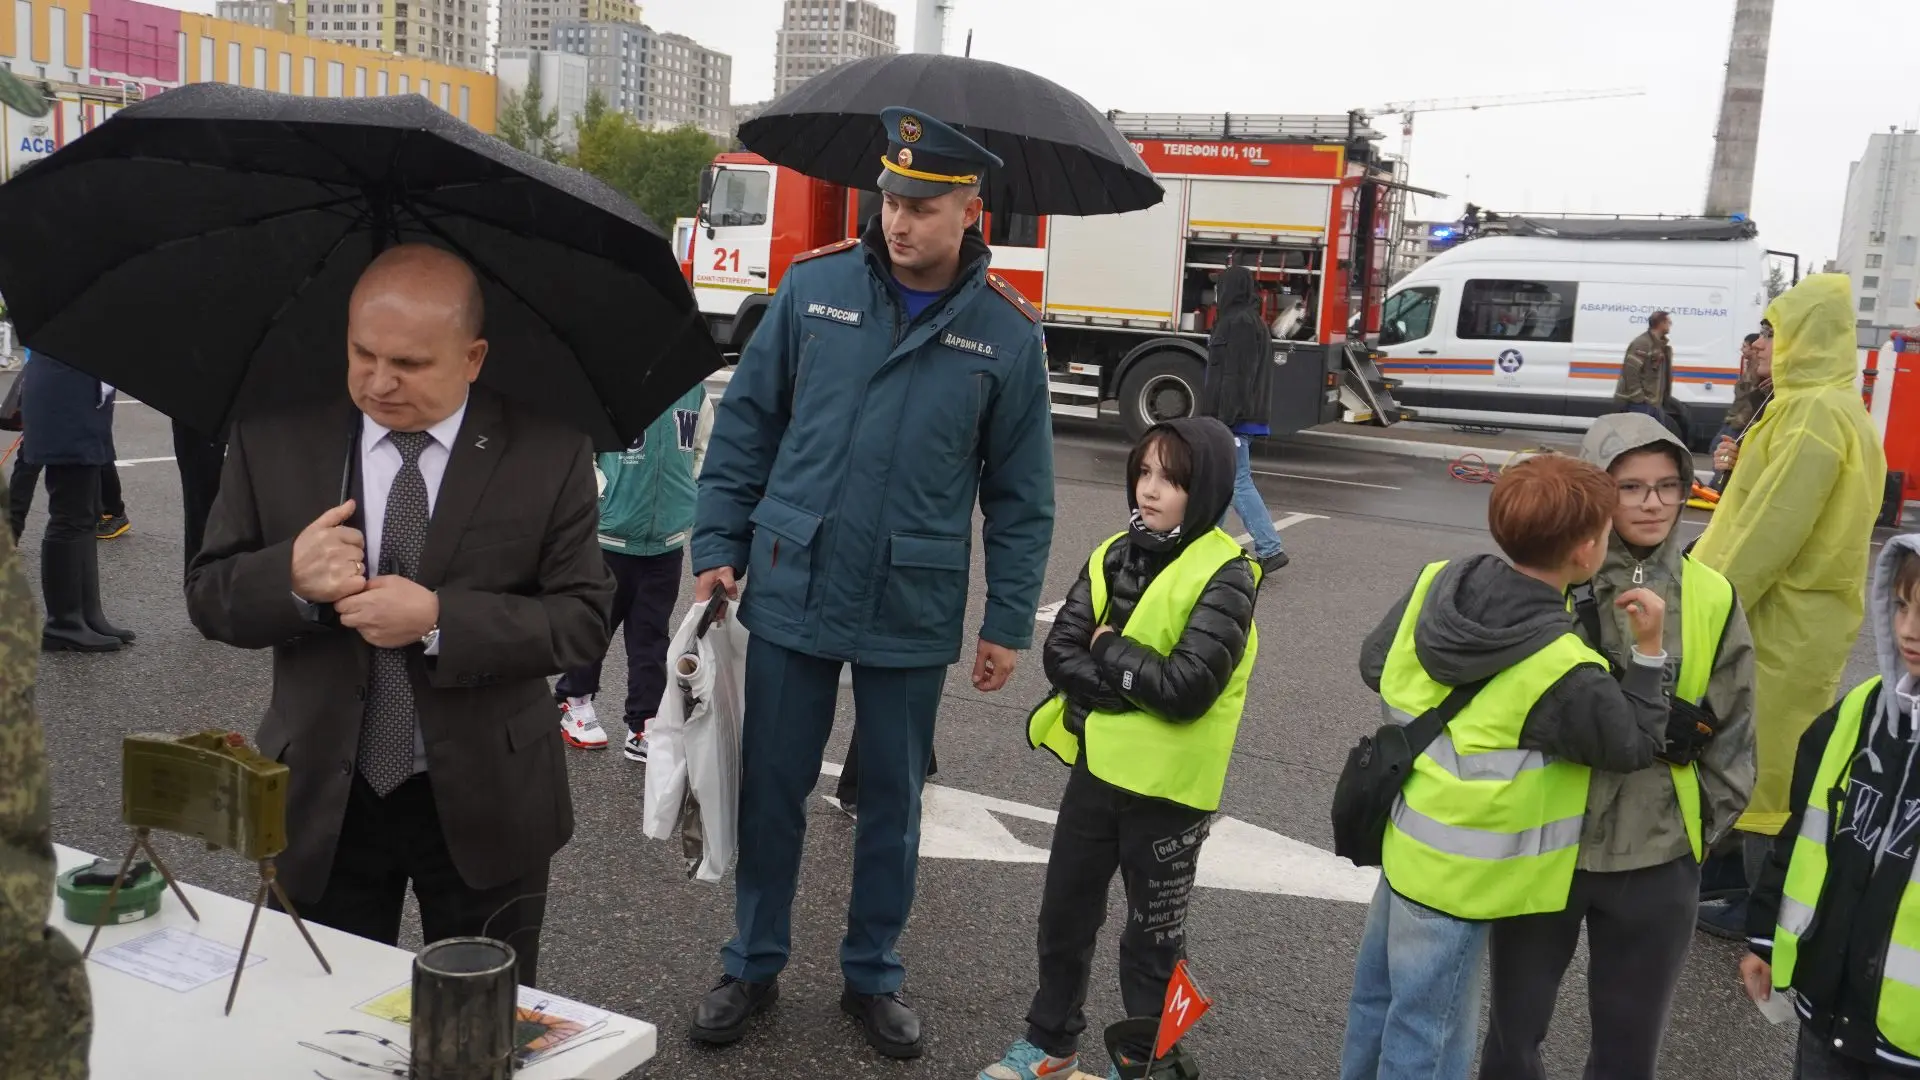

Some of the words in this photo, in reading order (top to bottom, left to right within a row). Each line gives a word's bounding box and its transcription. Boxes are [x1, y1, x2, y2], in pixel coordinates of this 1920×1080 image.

[1163, 143, 1218, 156] ТЕЛЕФОН
[1221, 146, 1239, 160] 01,
[1242, 147, 1262, 159] 101
[713, 247, 739, 272] 21
[808, 303, 826, 315] МЧС
[827, 306, 860, 322] РОССИИ
[945, 333, 976, 351] ДАРВИН
[977, 342, 994, 355] Е.О.
[474, 435, 489, 450] Z
